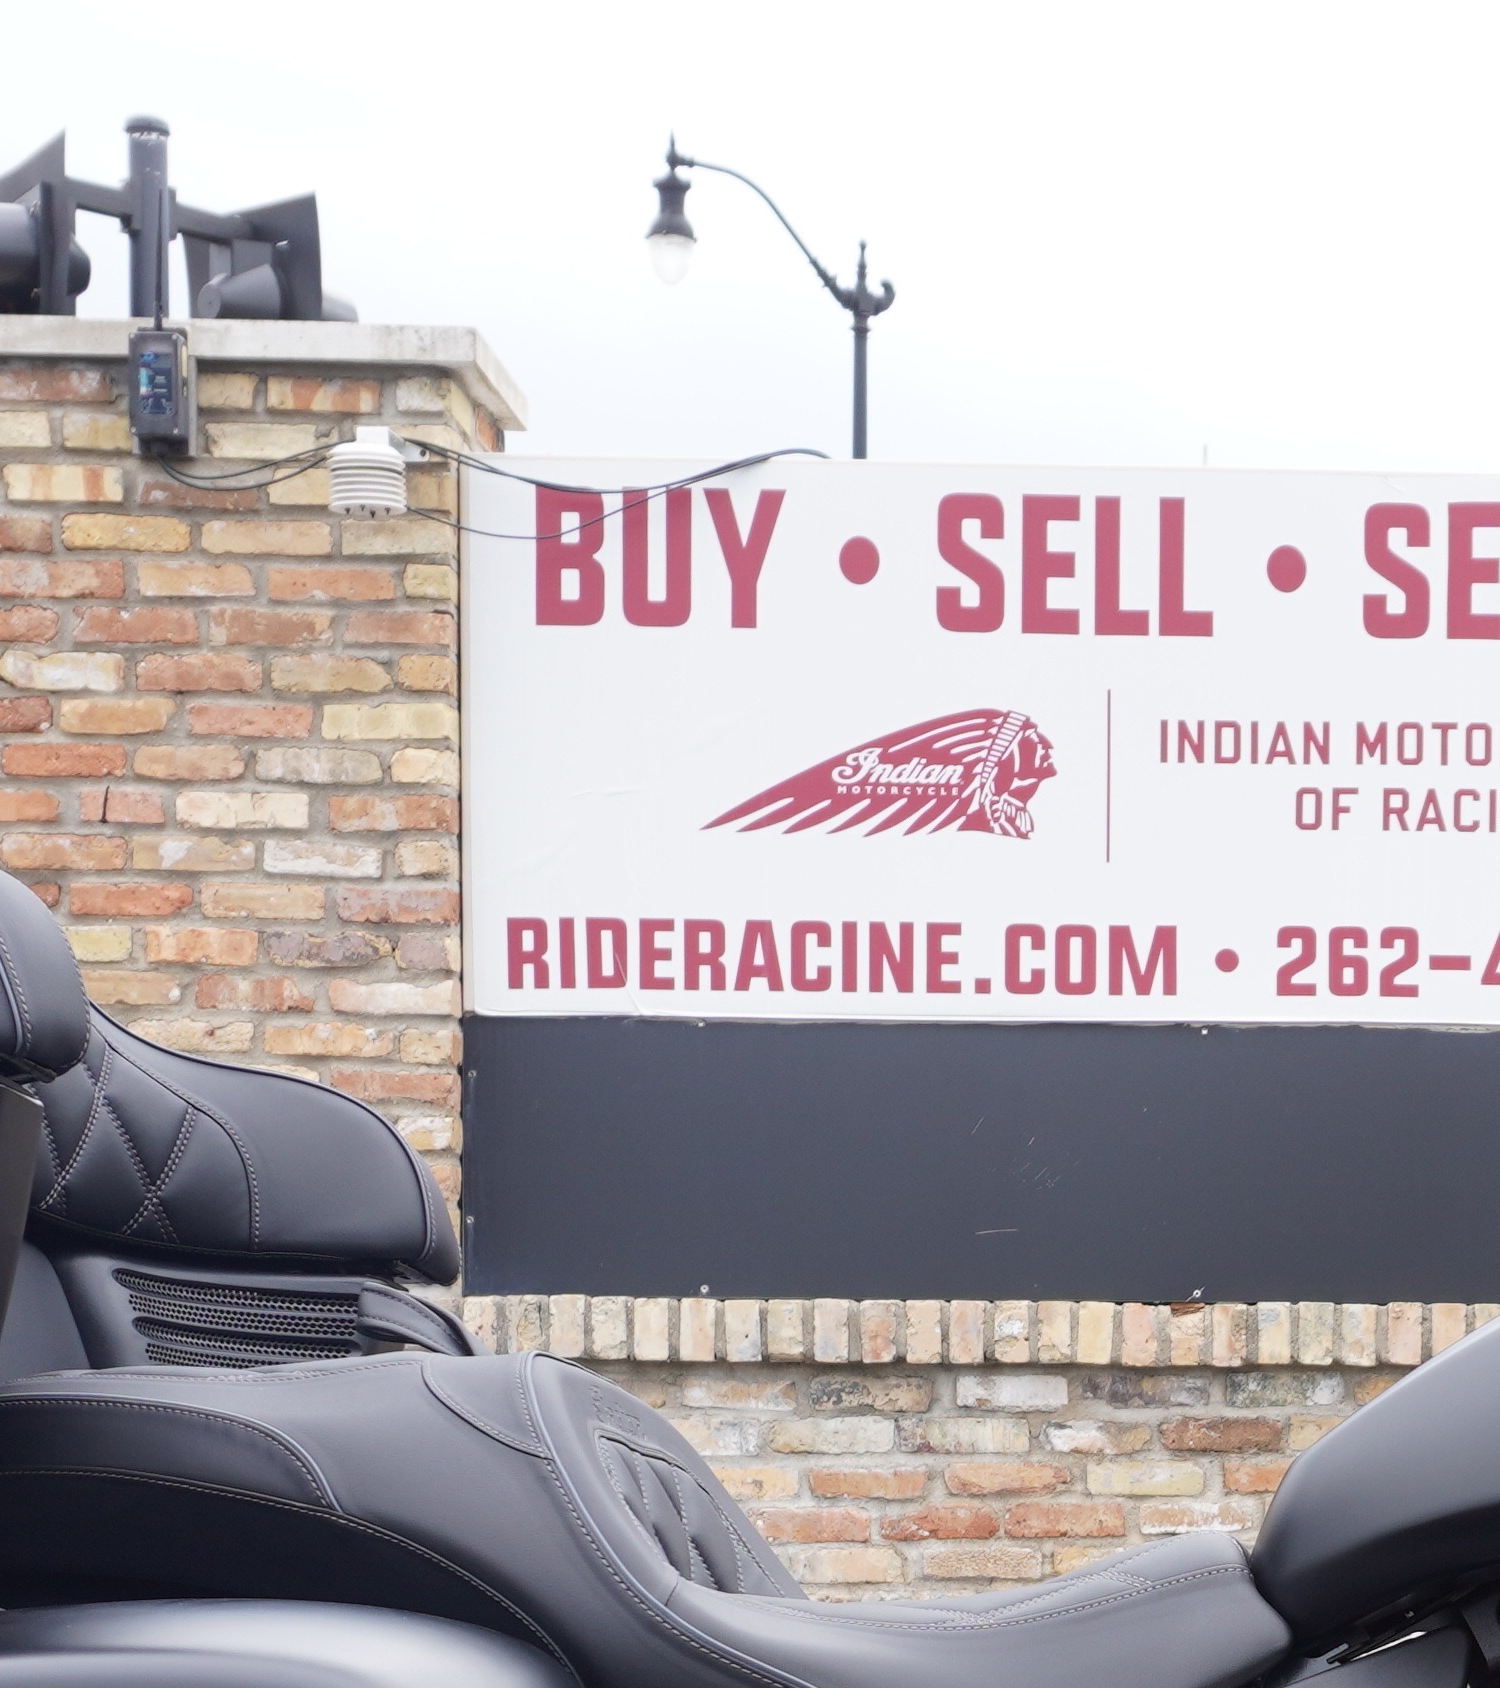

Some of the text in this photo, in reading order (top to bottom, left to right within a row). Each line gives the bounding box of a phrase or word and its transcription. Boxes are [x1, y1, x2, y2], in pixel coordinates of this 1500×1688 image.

[535, 485, 785, 628] BUY
[936, 493, 1213, 637] SELL
[1160, 719, 1331, 766] INDIAN
[831, 747, 965, 785] Indian
[837, 785, 959, 796] MOTORCYCLE
[1295, 786, 1358, 831] OF
[506, 917, 1178, 996] RIDERACINE.COM
